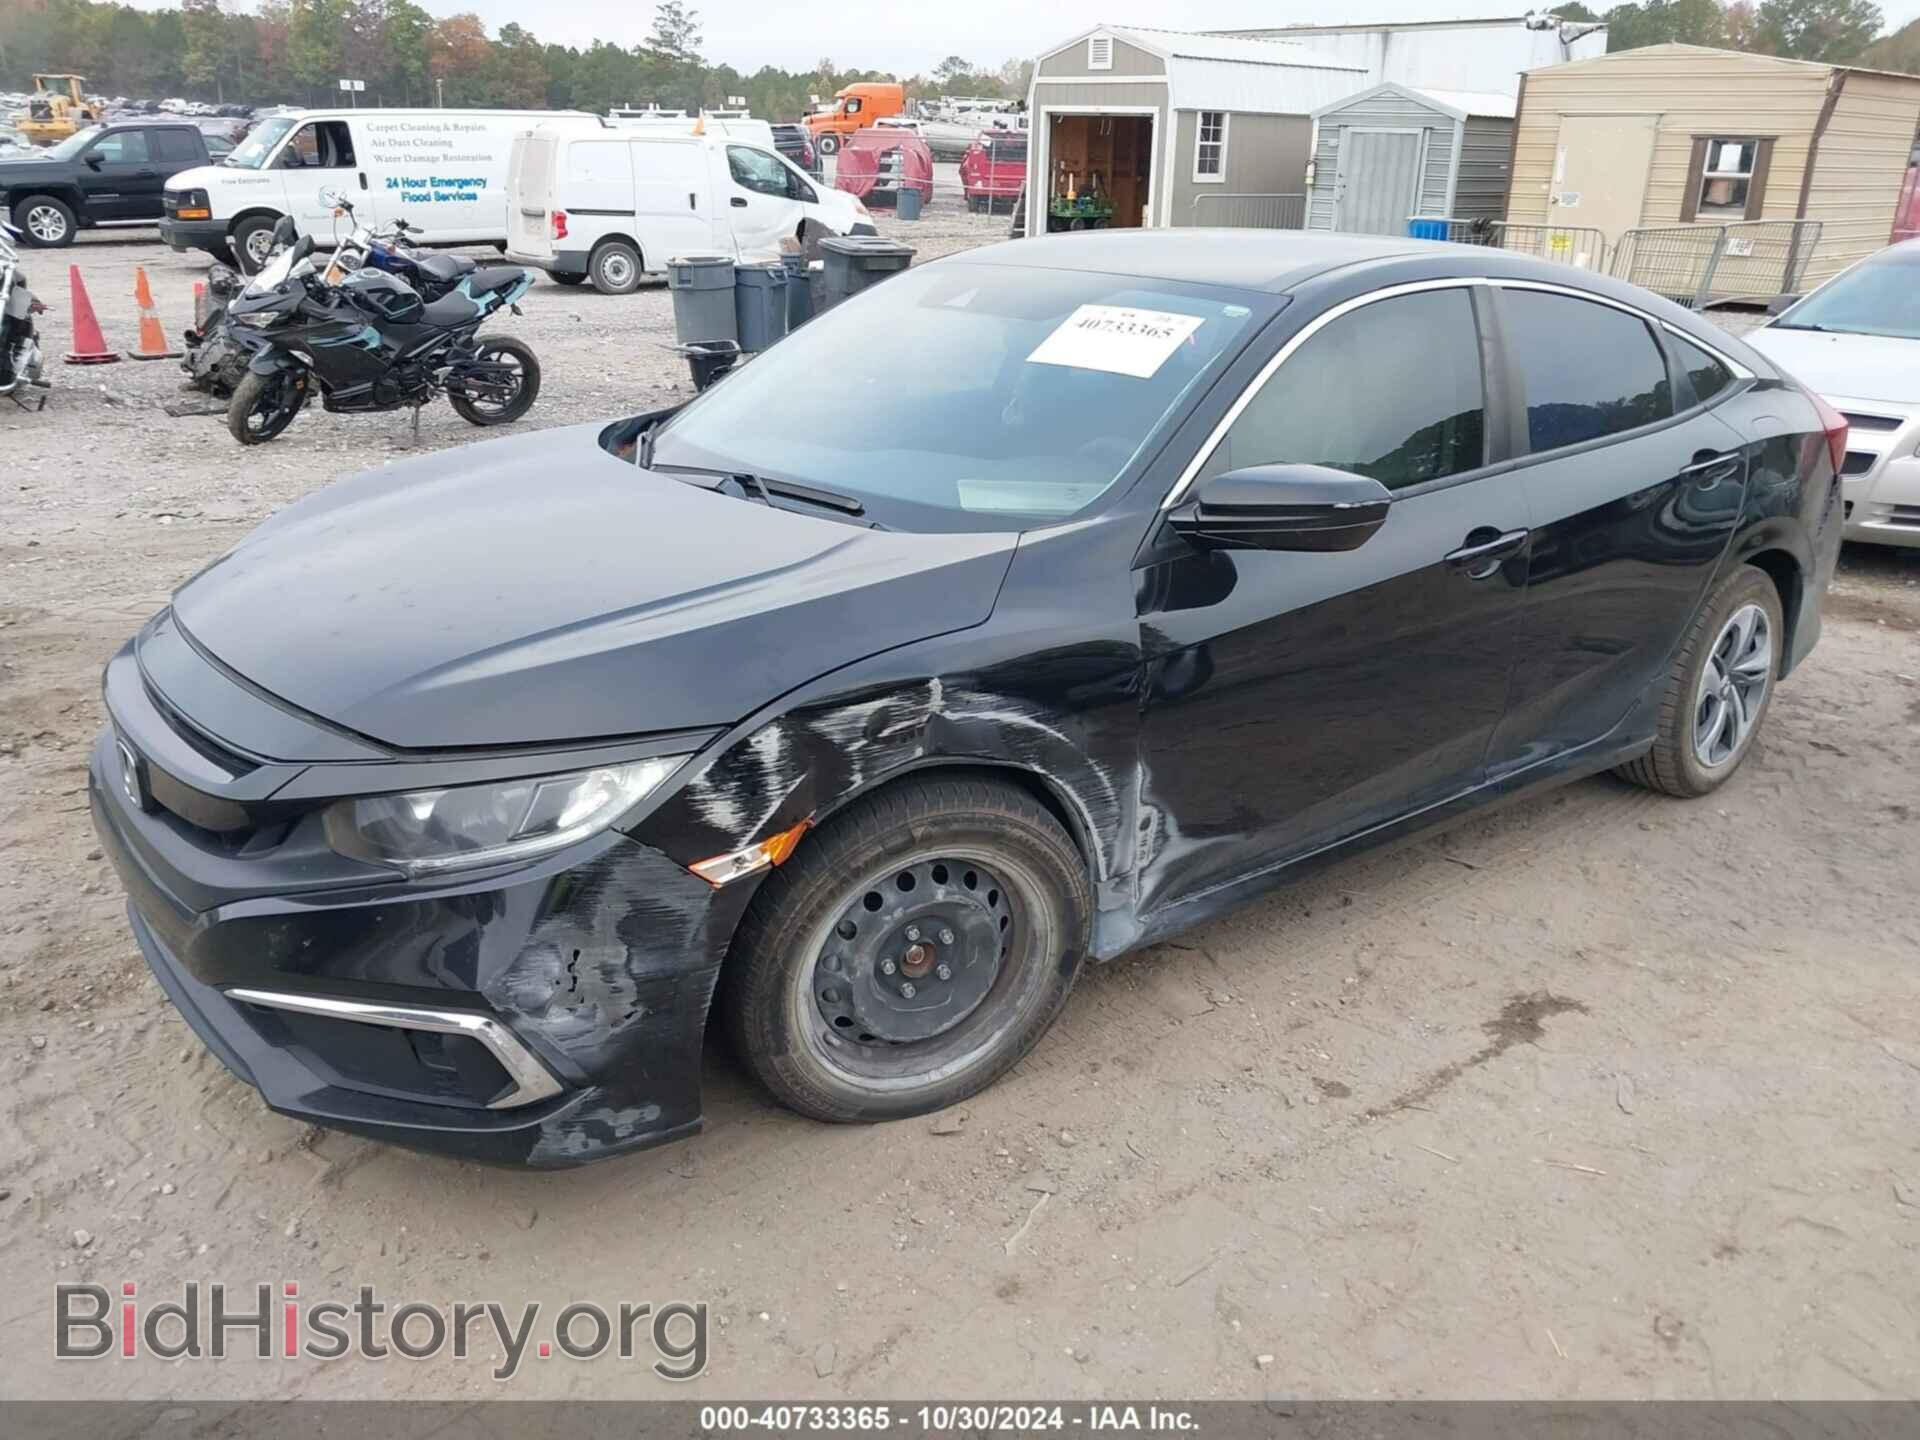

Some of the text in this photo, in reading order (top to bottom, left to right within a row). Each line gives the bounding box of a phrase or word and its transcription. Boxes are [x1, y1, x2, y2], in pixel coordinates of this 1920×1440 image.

[366, 122, 487, 133] Carpet Cleaning & Repairs
[371, 138, 453, 148] Air Duct Cleaning
[374, 152, 493, 164] Water Damage Restoration
[385, 176, 487, 189] 24 Hour Emergency
[401, 191, 478, 202] Flood Services
[1073, 318, 1175, 339] 40733365
